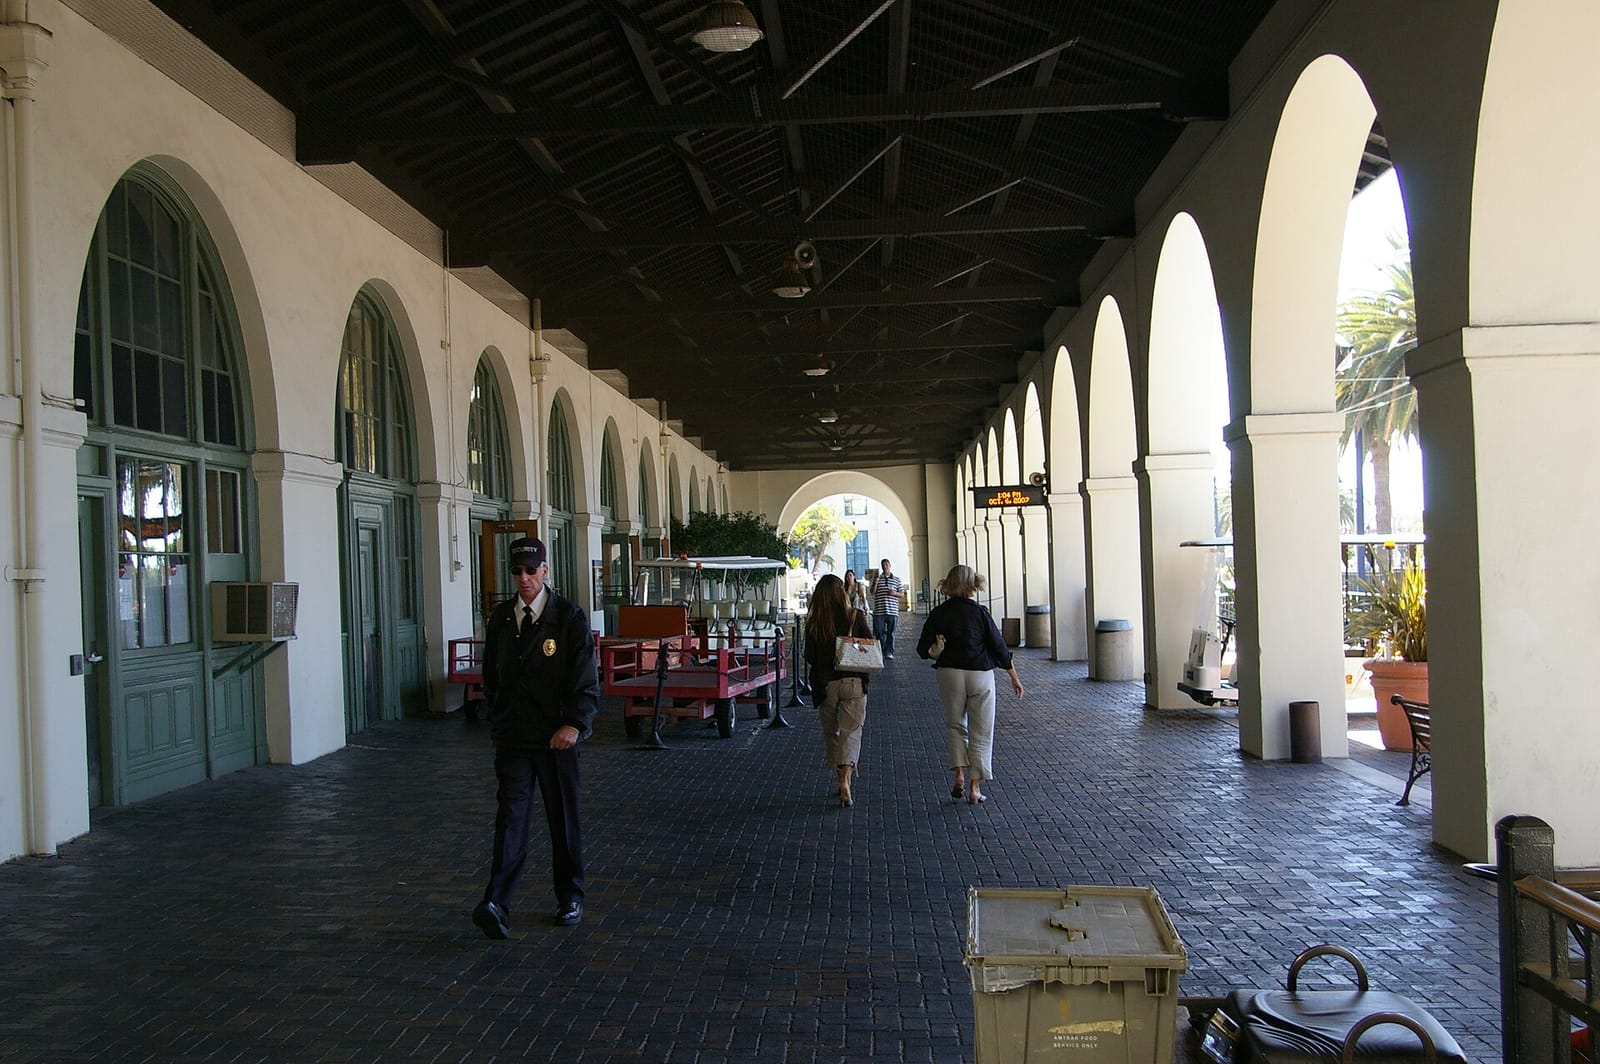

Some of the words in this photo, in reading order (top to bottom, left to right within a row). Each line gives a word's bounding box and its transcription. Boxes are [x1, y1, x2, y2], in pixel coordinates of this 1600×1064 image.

[997, 491, 1011, 499] 1:04
[1012, 496, 1030, 504] 2007
[511, 546, 538, 554] SECURITY
